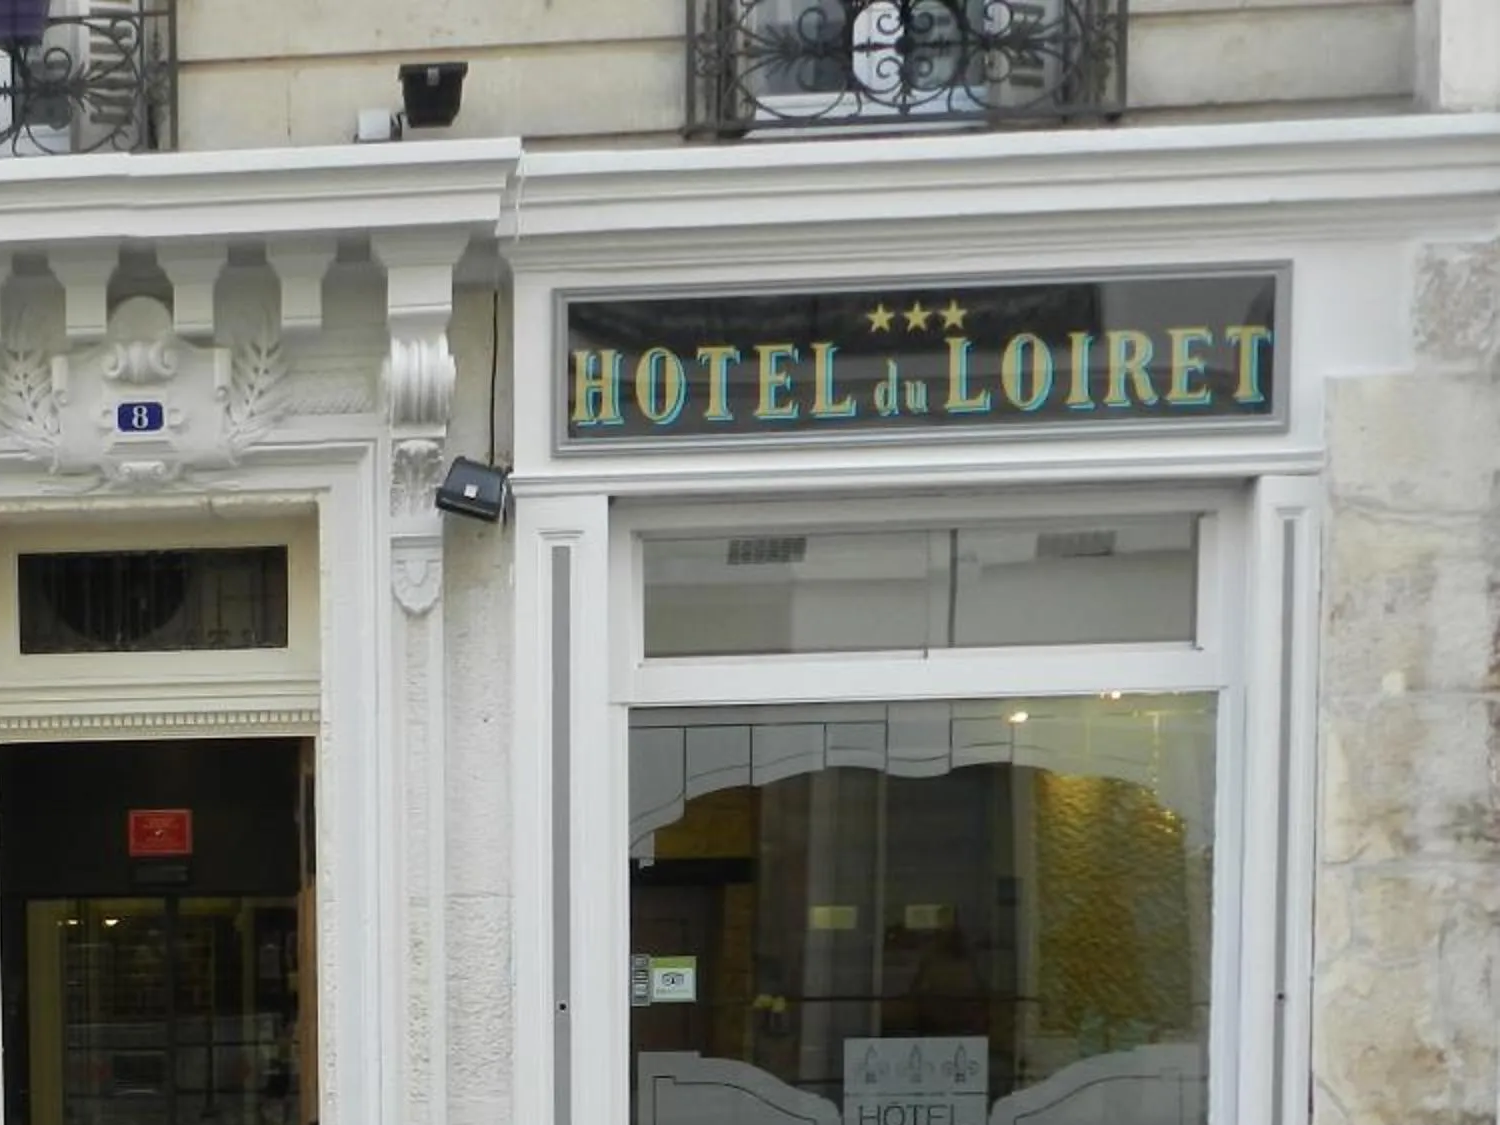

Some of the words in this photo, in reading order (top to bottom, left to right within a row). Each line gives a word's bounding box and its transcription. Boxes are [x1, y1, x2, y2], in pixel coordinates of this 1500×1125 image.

[570, 340, 857, 427] HOTEL
[874, 359, 929, 417] du
[944, 325, 1273, 412] LOIRET
[131, 405, 149, 429] 8
